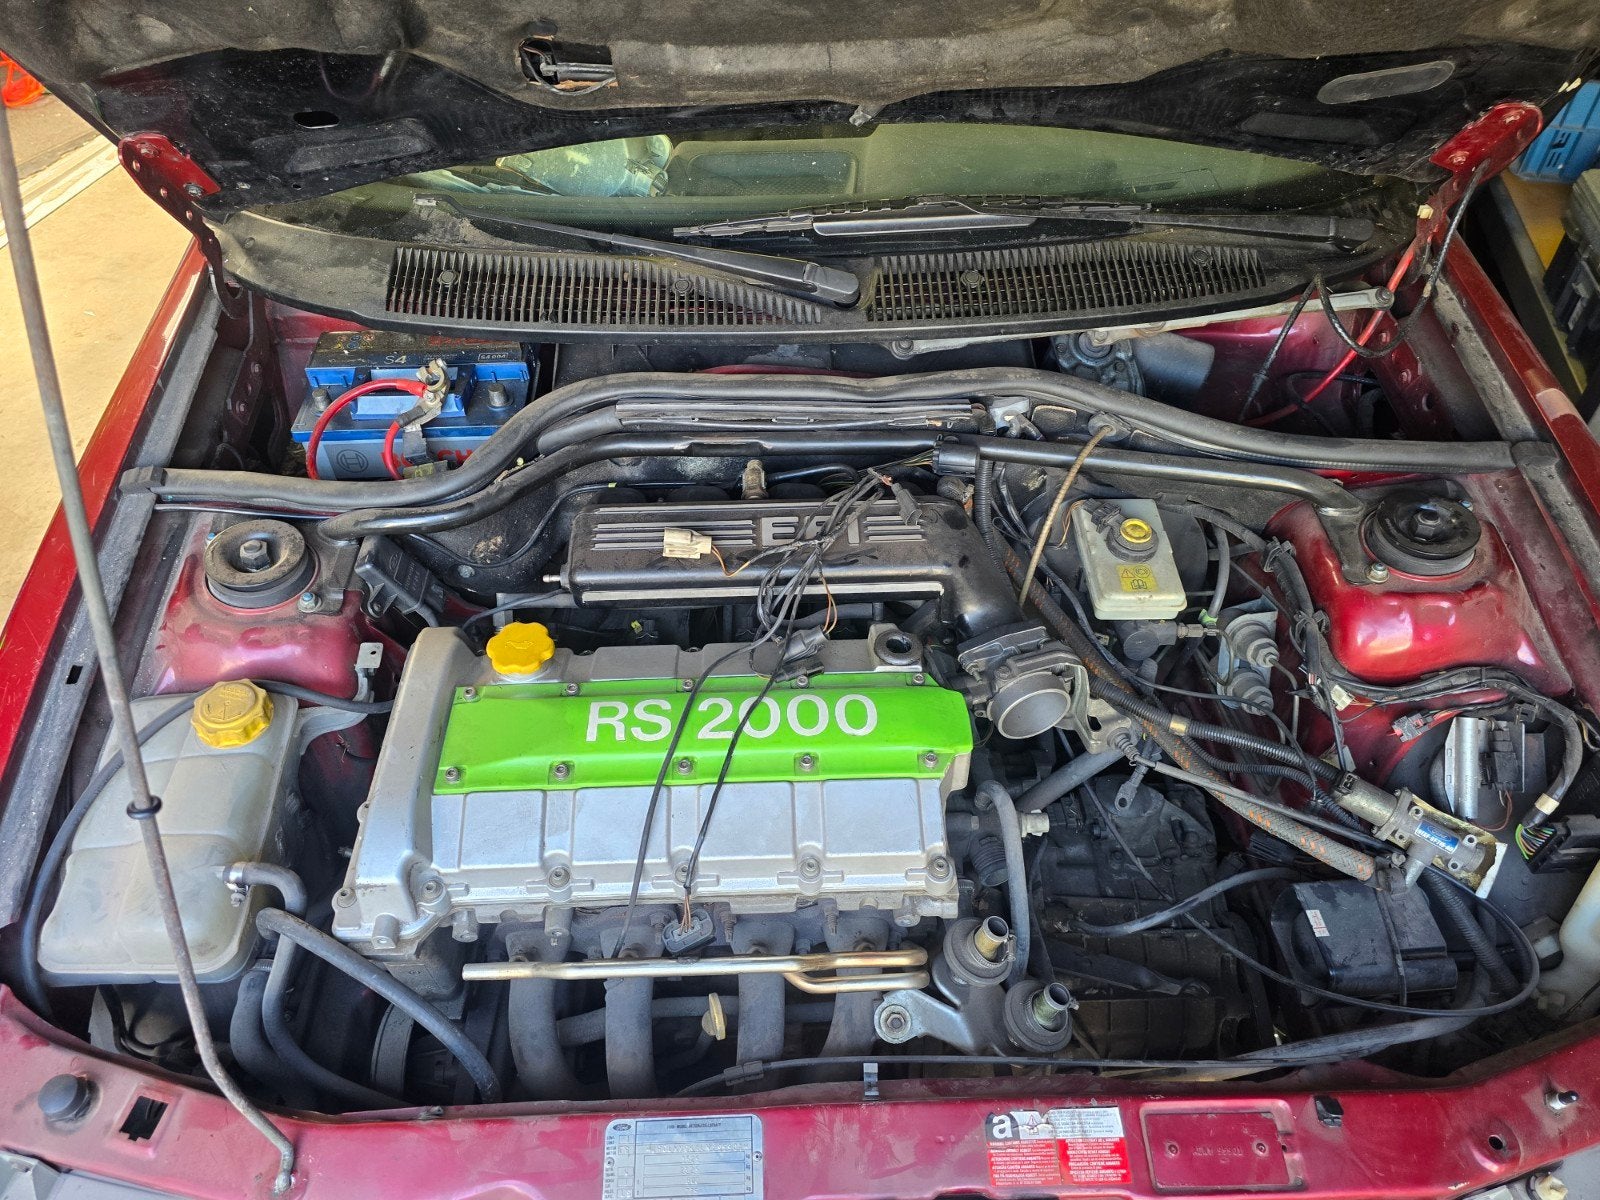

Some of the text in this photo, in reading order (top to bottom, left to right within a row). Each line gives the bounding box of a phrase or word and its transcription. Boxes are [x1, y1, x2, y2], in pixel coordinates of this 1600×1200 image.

[384, 355, 407, 365] S4
[761, 515, 860, 546] EFI
[585, 693, 878, 742] RS 2000
[992, 1113, 1014, 1139] a
